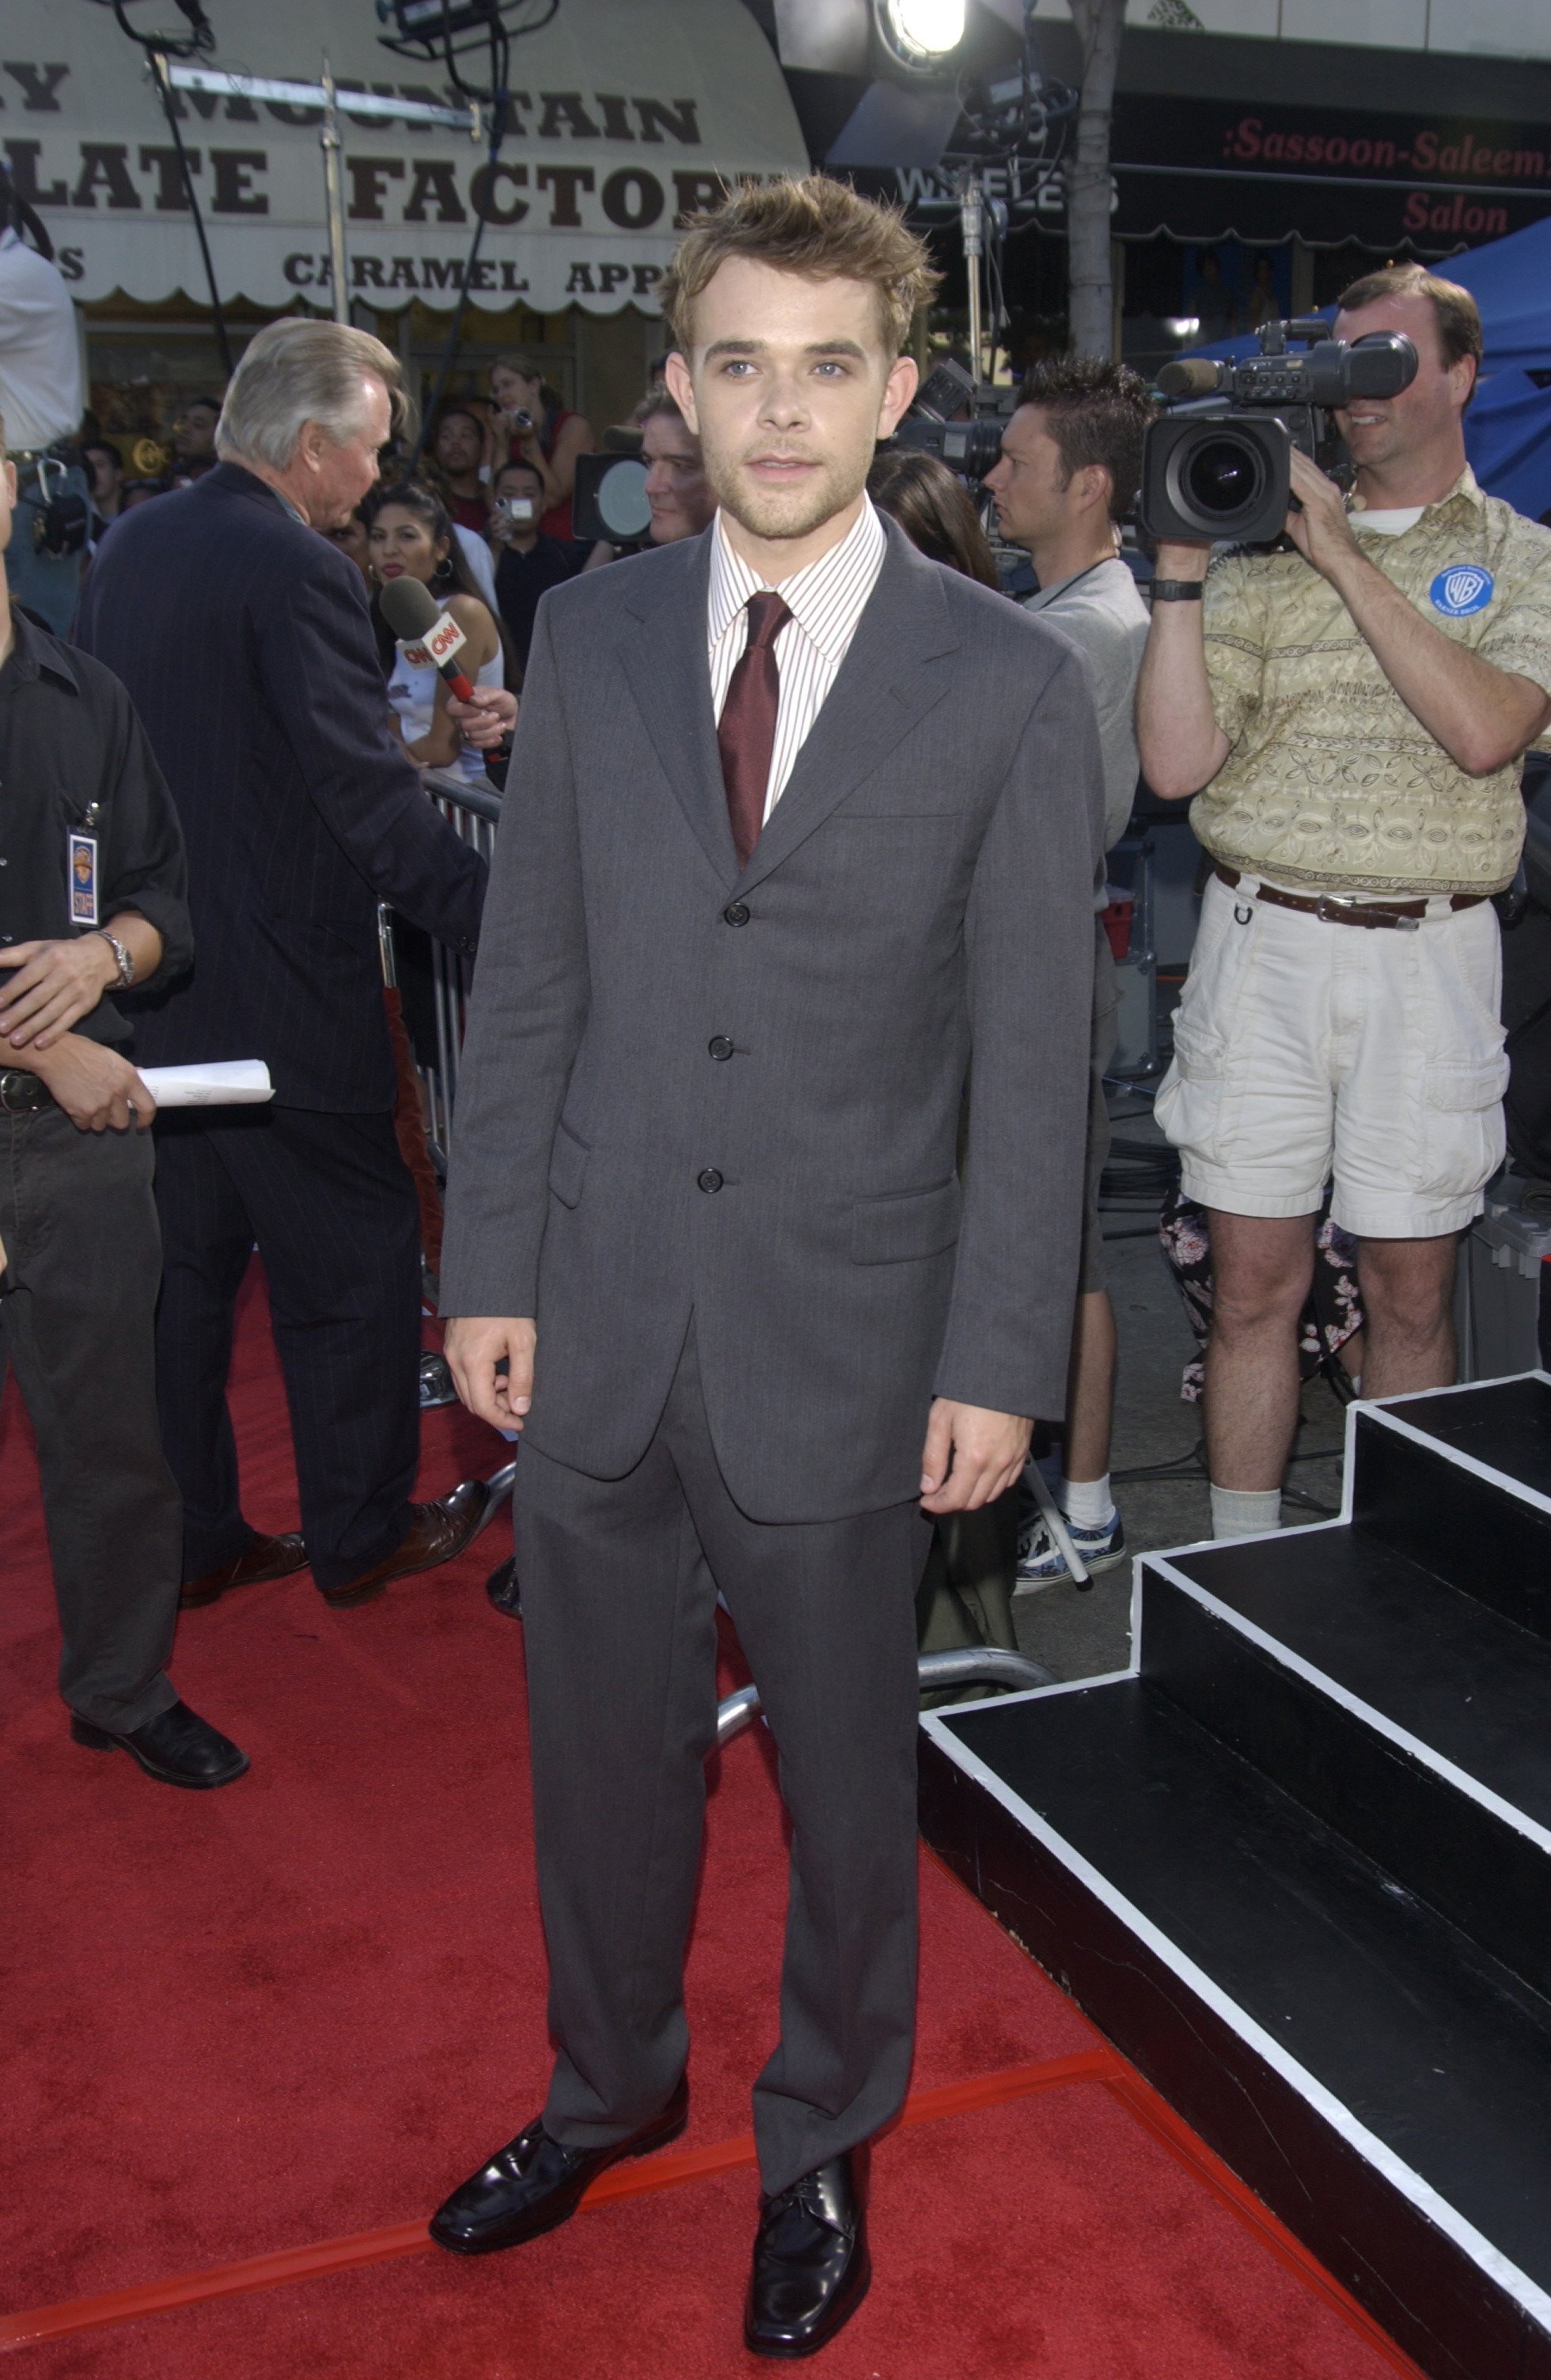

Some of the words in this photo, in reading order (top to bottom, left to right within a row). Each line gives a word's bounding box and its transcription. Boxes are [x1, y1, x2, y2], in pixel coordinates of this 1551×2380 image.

[346, 155, 787, 231] FACTOR
[1403, 191, 1508, 233] Salon
[283, 252, 530, 292] CARAMEL
[564, 261, 671, 294] APP
[432, 622, 459, 654] CNN
